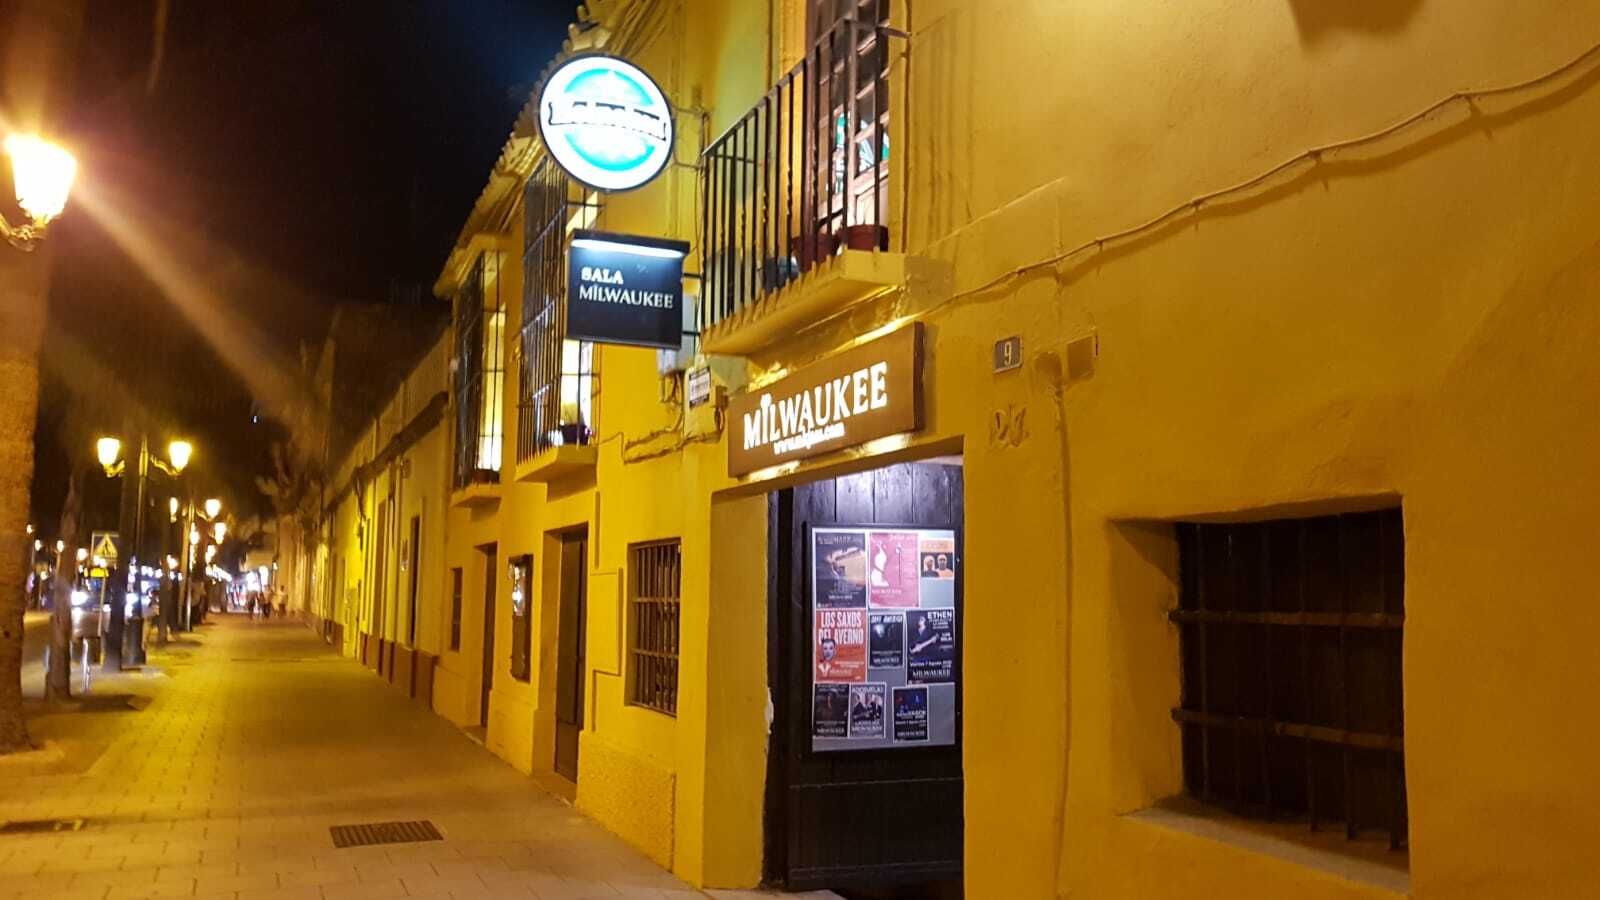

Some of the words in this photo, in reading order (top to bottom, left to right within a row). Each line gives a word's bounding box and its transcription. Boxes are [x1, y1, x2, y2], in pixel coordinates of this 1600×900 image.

[580, 266, 624, 285] SALA
[1004, 340, 1012, 366] 9
[820, 611, 836, 628] LOS
[836, 611, 862, 628] SAXOS
[818, 628, 832, 645] DEL
[834, 628, 864, 645] AVERNO
